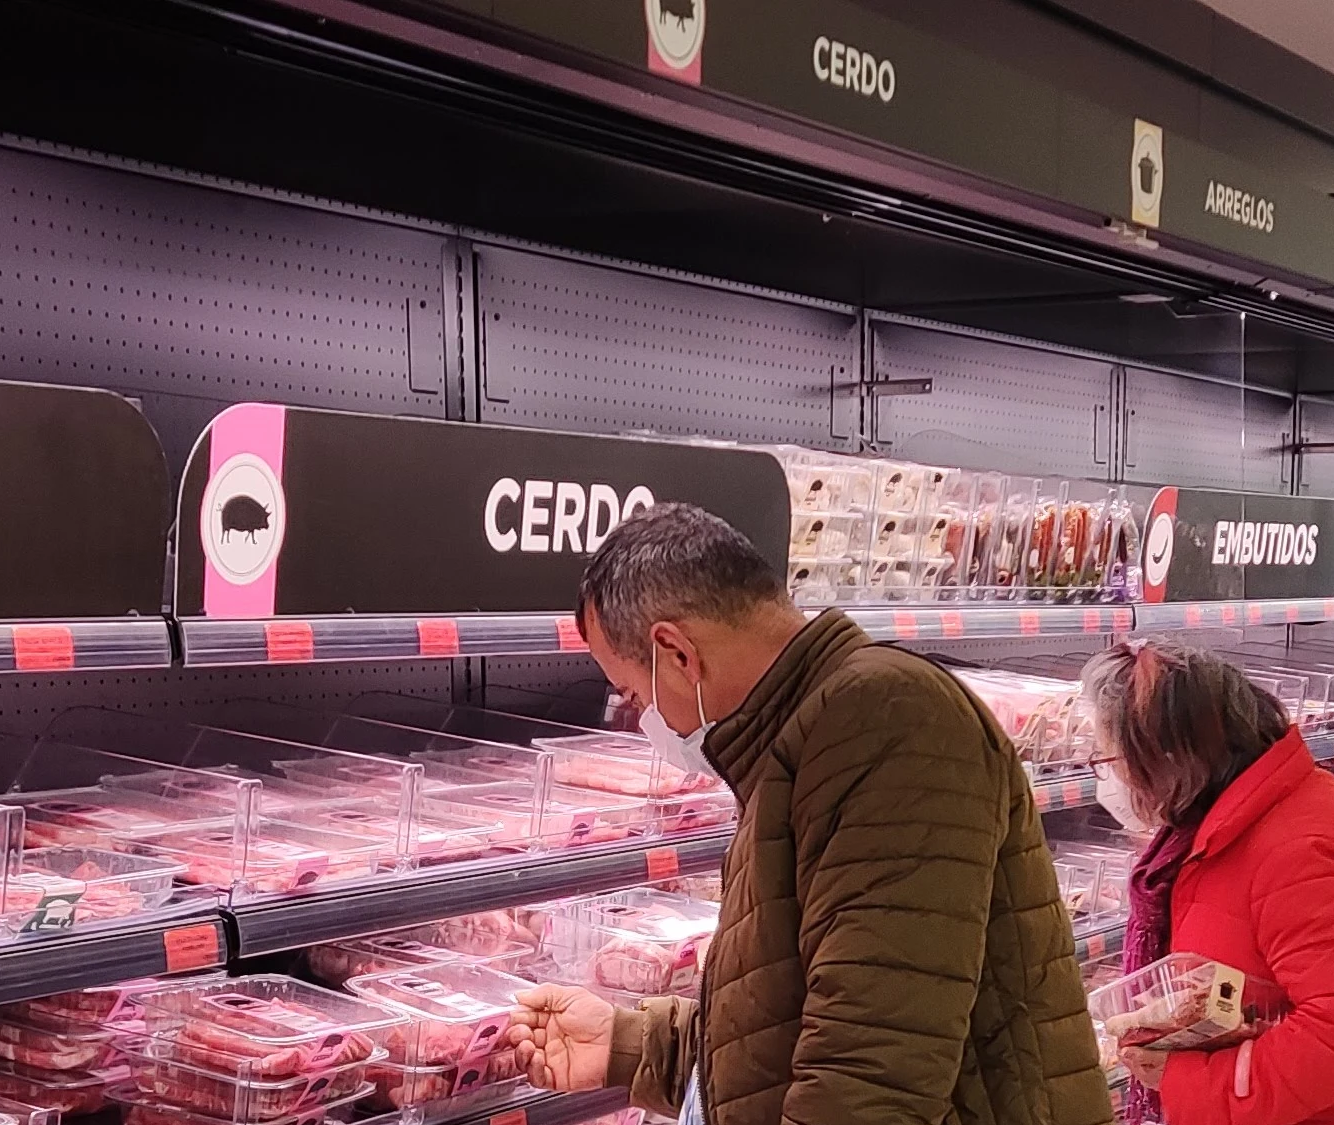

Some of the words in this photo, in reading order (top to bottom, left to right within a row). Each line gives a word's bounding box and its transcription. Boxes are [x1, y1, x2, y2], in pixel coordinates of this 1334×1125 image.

[812, 35, 896, 103] CERDO
[1204, 180, 1274, 234] ARREGLOS
[1211, 520, 1319, 567] EMBUTIDOS
